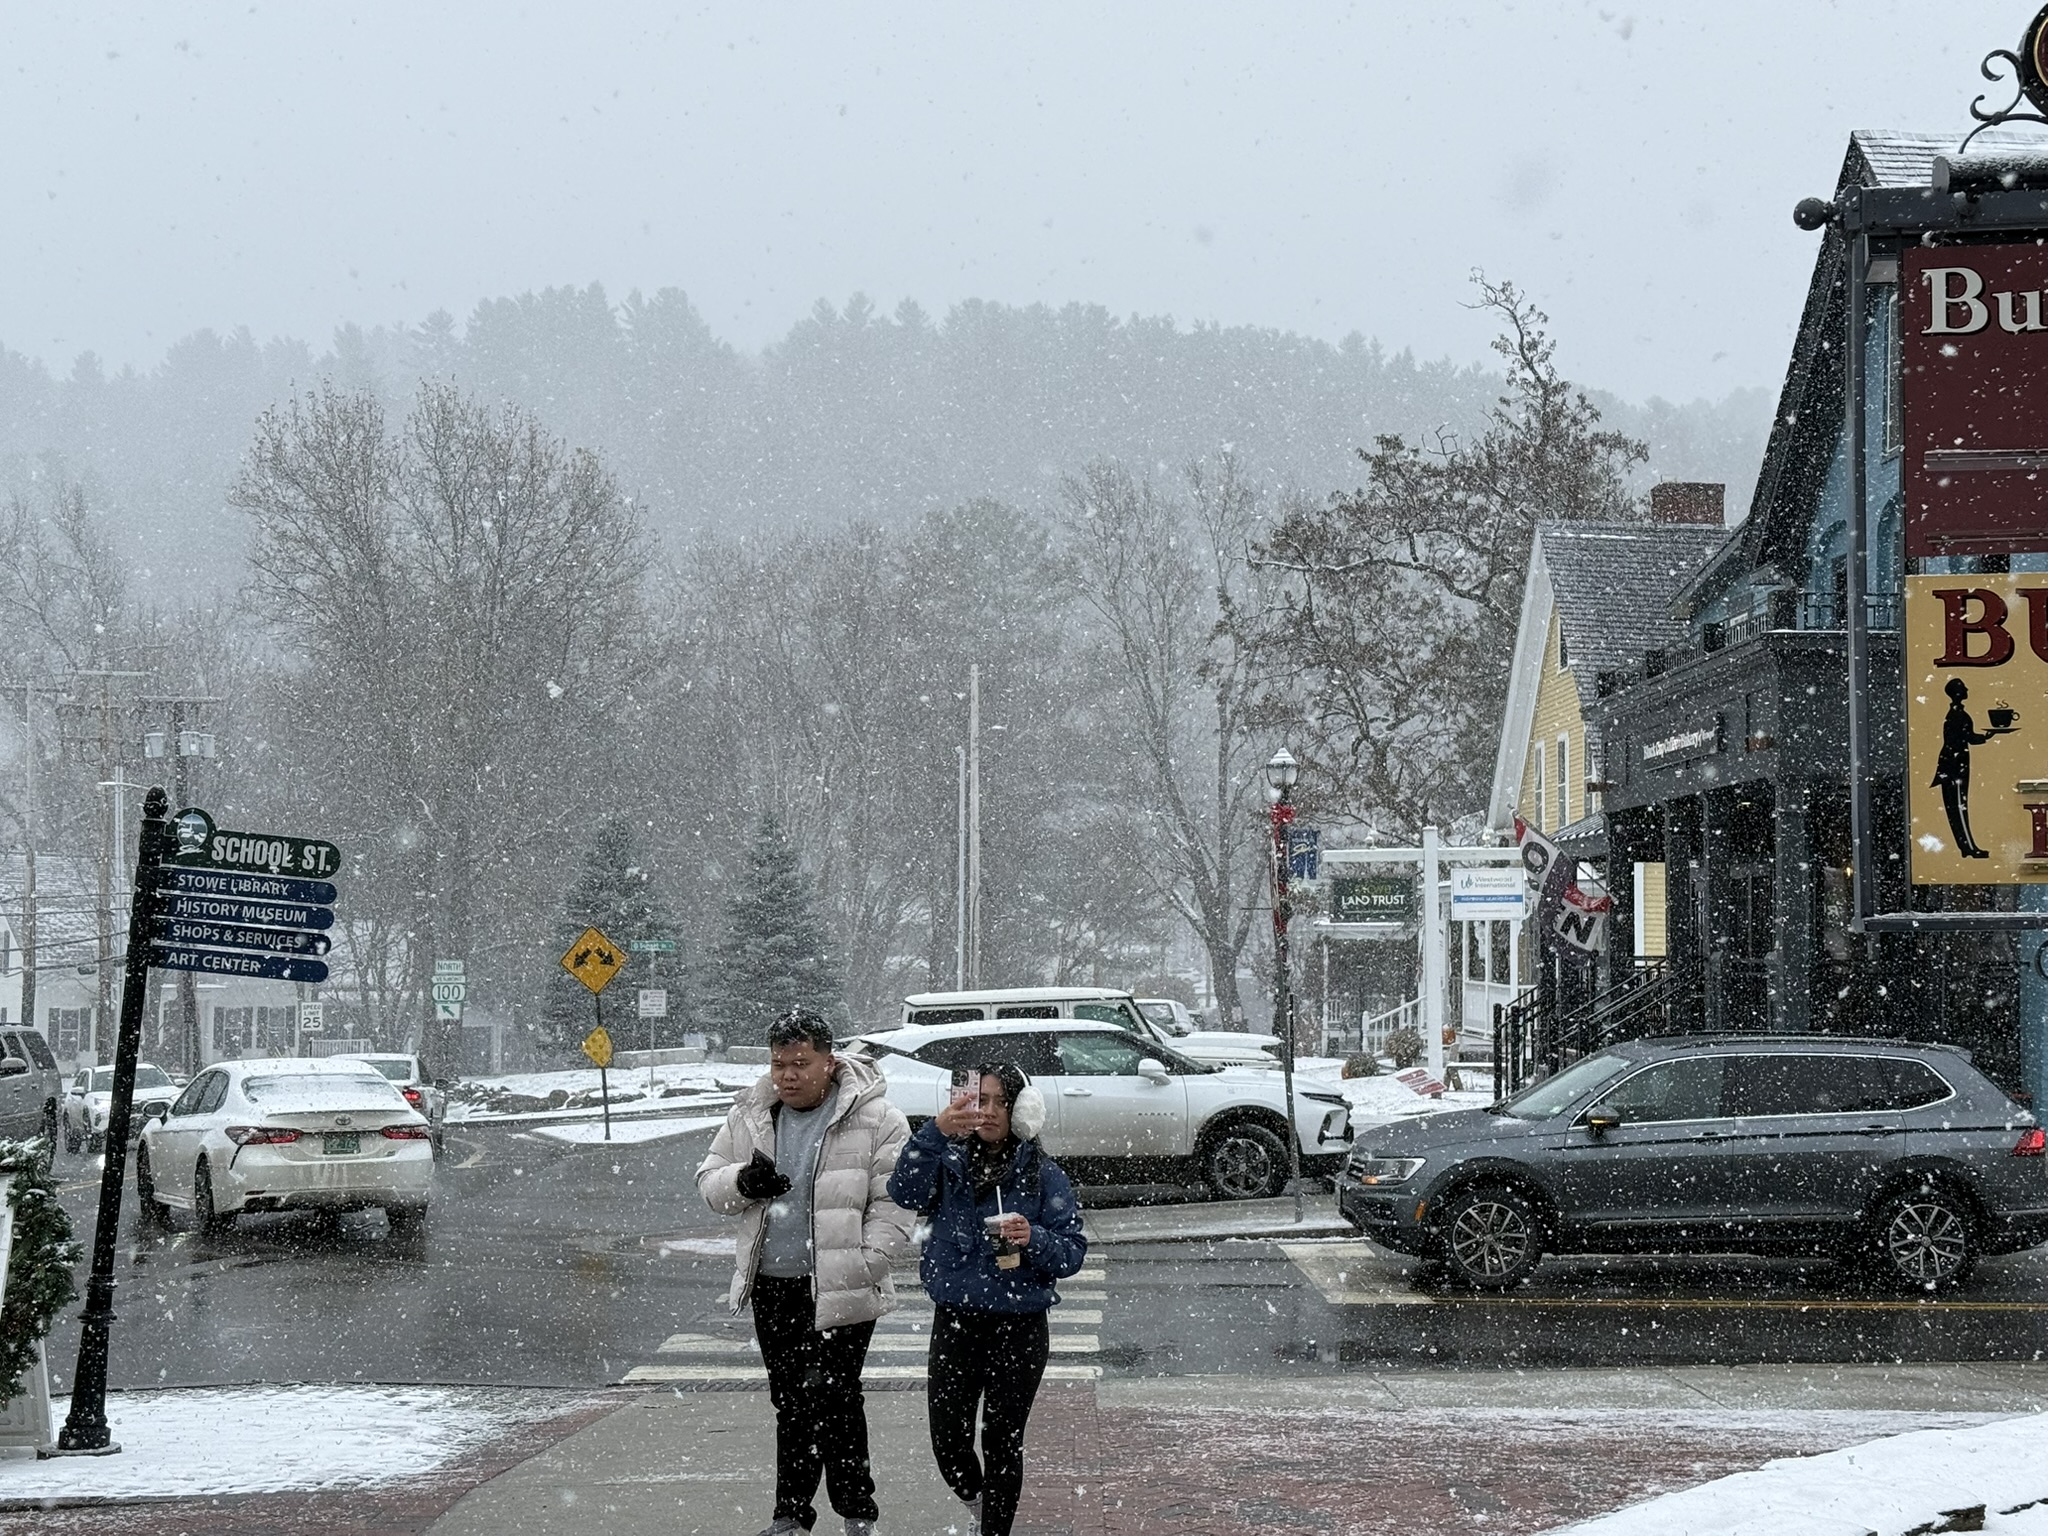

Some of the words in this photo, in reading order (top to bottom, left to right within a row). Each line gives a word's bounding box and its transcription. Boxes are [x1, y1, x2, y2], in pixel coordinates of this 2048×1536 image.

[211, 835, 294, 867] SCHOOL
[302, 844, 331, 872] ST.
[178, 874, 227, 890] STOWE
[230, 878, 289, 896] LIBRARY
[1341, 895, 1370, 905] LAND
[1371, 894, 1405, 905] TRUST
[176, 900, 239, 917] HISTORY
[242, 906, 307, 922] MUSEUM
[173, 925, 220, 940] SHOPS
[223, 929, 233, 941] &
[237, 931, 301, 949] SERVICES
[166, 952, 199, 966] ART
[202, 955, 260, 973] CENTER
[437, 961, 461, 971] NORTH
[437, 985, 461, 1000] 100
[303, 1016, 321, 1028] 25
